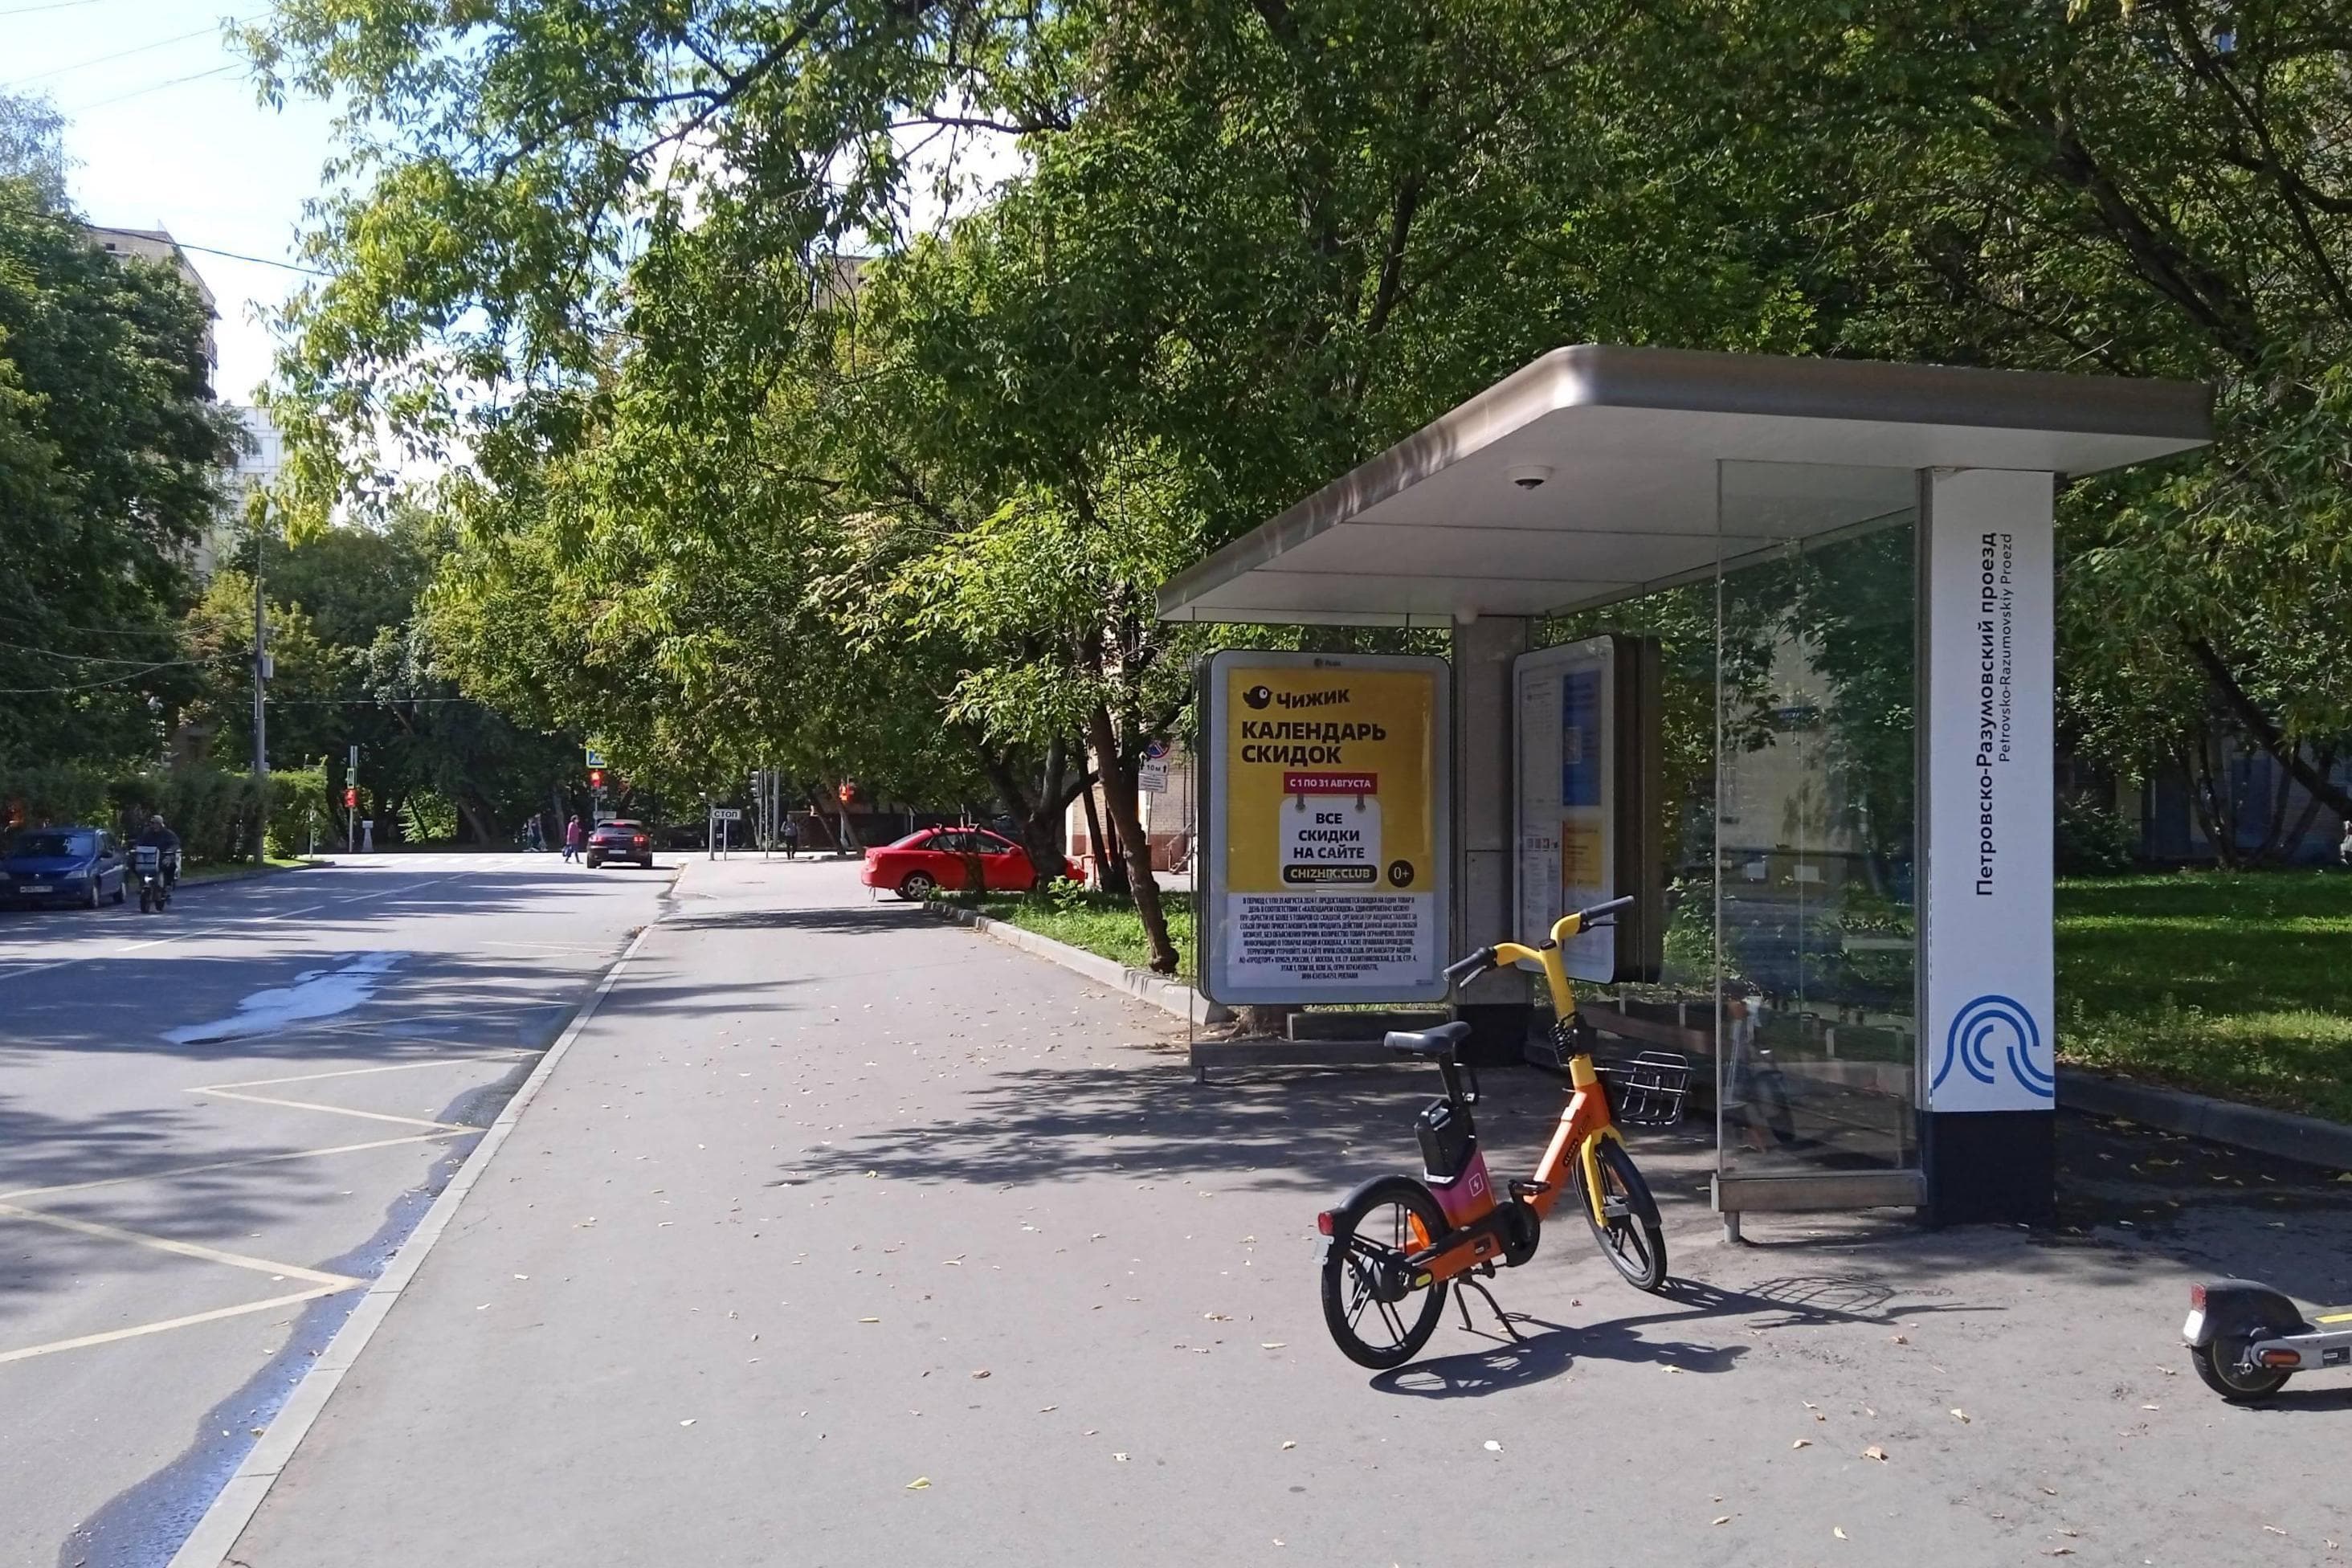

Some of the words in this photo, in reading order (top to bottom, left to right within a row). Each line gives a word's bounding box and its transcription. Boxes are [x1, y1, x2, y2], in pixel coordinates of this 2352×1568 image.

[2000, 533, 2012, 585] Proezd
[1981, 532, 1998, 612] проезд
[1999, 587, 2015, 762] Petrovsko-Razumovskiy
[1242, 721, 1386, 744] КАЛЕНДАРЬ
[1241, 745, 1342, 766] СКИДОК
[1976, 620, 1997, 896] Петровско-Разумовский
[1290, 778, 1296, 787] С
[1298, 778, 1302, 787] 1
[1304, 778, 1317, 788] ПО
[1319, 778, 1329, 788] 31
[1330, 778, 1371, 788] АВГУСТА
[1316, 813, 1342, 824] ВСЕ
[1298, 830, 1360, 843] СКИДКИ
[1293, 847, 1313, 859] НА
[1317, 844, 1365, 860] САЙТЕ
[1291, 867, 1370, 879] CHIZHIK.CLUB
[1394, 867, 1409, 879] 0+
